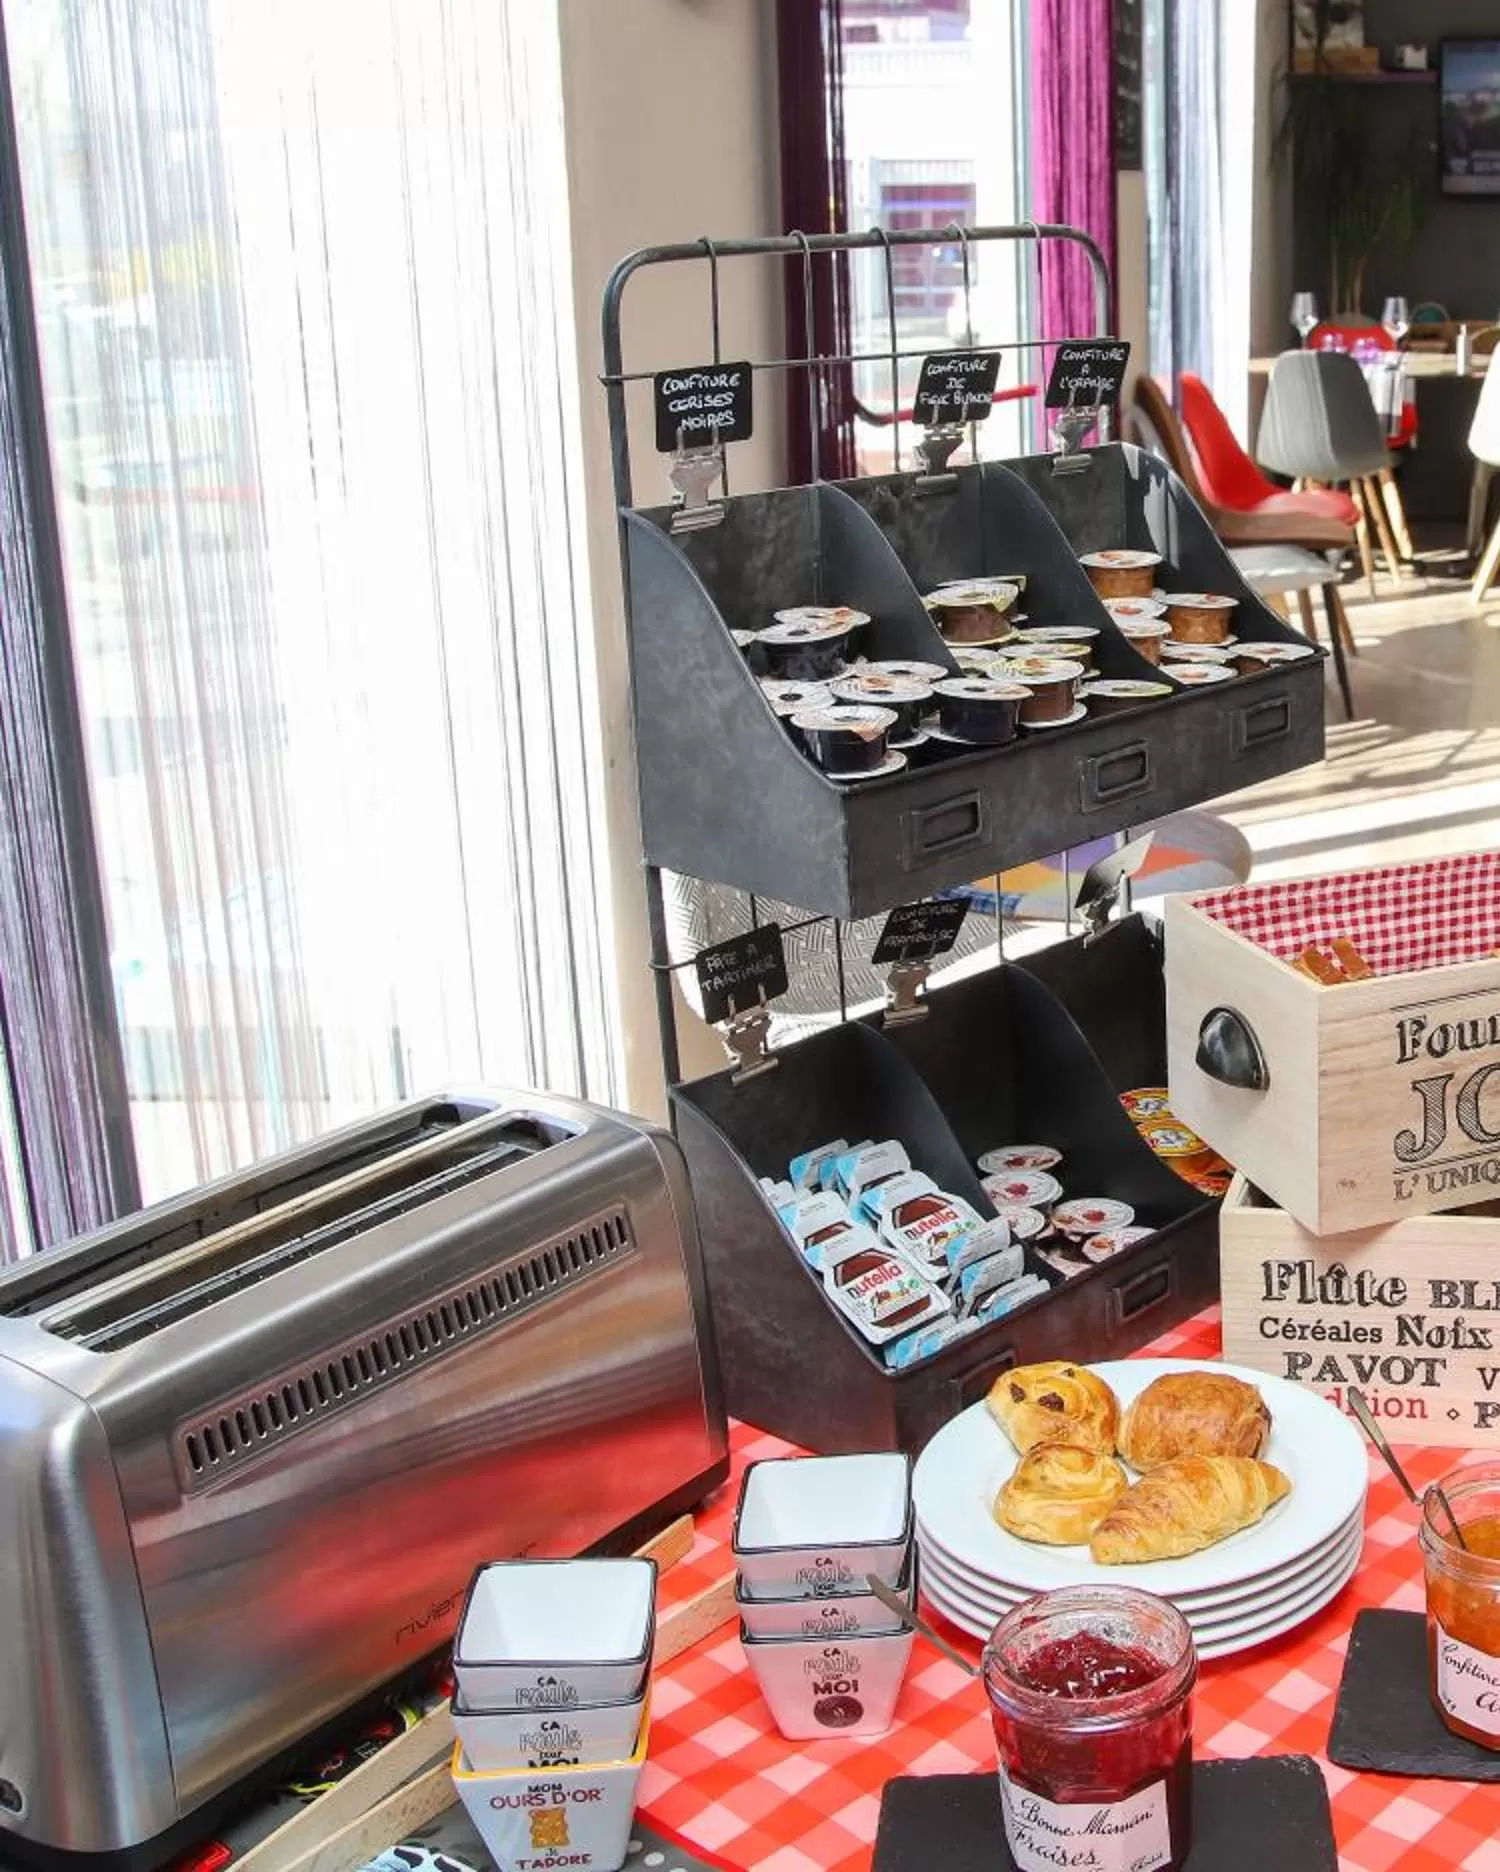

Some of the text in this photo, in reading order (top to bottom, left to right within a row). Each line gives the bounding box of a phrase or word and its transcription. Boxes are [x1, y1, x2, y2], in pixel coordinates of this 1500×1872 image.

[904, 1208, 960, 1240] nutella
[847, 1263, 903, 1299] nutella
[1261, 1259, 1407, 1308] Flûte
[1259, 1317, 1383, 1343] Céréales
[1395, 1313, 1494, 1349] Noix
[1282, 1351, 1447, 1387] PAVOT
[812, 1679, 859, 1695] MOI
[489, 1787, 602, 1809] OURS D'OR
[527, 1783, 563, 1793] MON
[1016, 1797, 1154, 1837] Bonne Maman
[1012, 1821, 1103, 1867] Fraises
